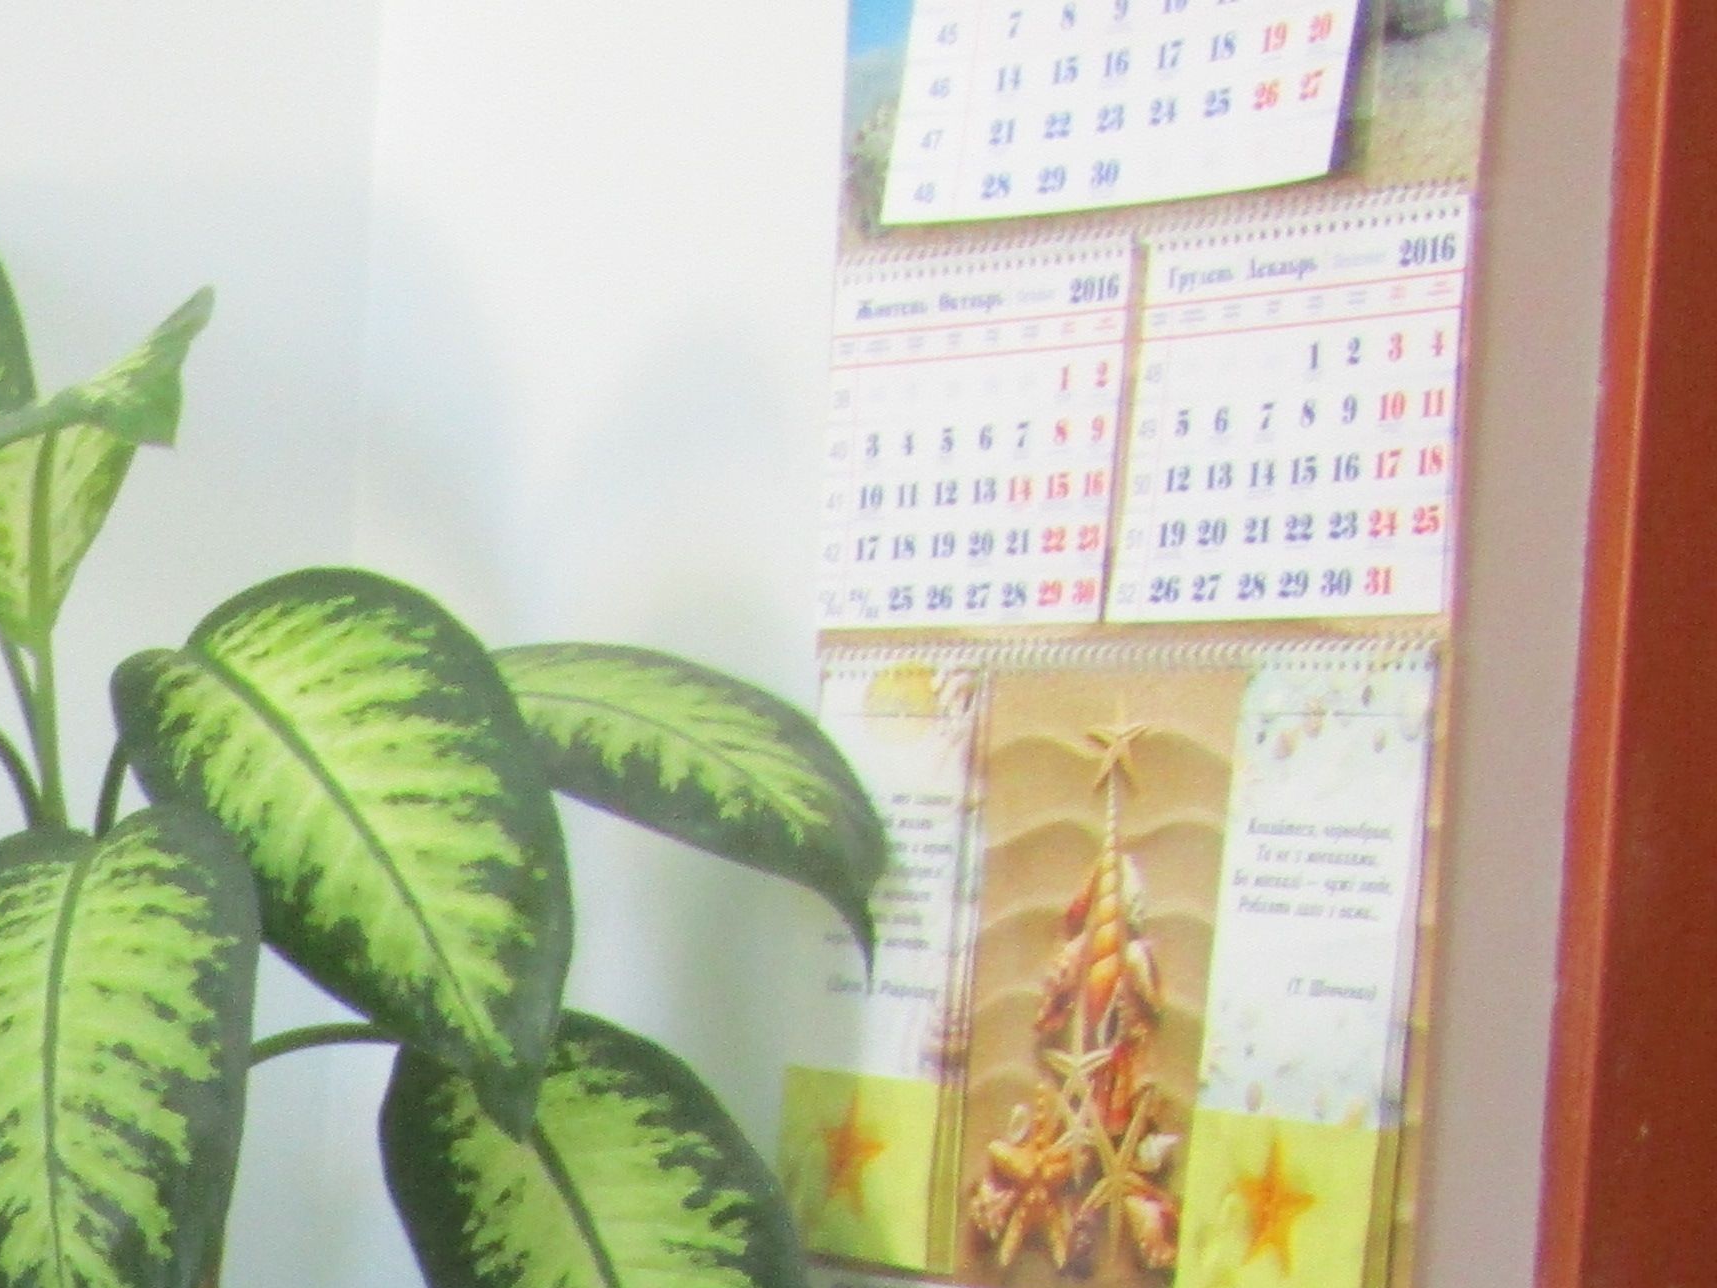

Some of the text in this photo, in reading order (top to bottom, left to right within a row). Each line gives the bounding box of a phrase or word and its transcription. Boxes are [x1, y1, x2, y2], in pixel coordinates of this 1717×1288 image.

[1009, 10, 1023, 38] 7
[997, 66, 1021, 92] 14
[1054, 56, 1079, 84] 15
[1105, 50, 1129, 77] 16
[1158, 39, 1183, 70] 17
[1211, 35, 1235, 60] 18
[1263, 21, 1290, 53] 19
[989, 119, 1015, 146] 21
[1044, 112, 1072, 139] 22
[1097, 104, 1125, 133] 23
[1150, 99, 1177, 126] 24
[1204, 88, 1230, 117] 25
[1253, 79, 1280, 110] 26
[1037, 166, 1067, 194] 29
[1091, 160, 1120, 186] 30
[1399, 233, 1456, 267] 2016
[1070, 274, 1119, 304] 2016
[1310, 341, 1320, 371] 1
[1347, 337, 1361, 365] 2
[1388, 333, 1405, 361] 3
[1061, 361, 1109, 391] 1 2
[1176, 410, 1190, 436] 5
[1214, 408, 1229, 433] 6
[1261, 402, 1274, 430] 7
[1300, 399, 1316, 427] 8
[1342, 395, 1358, 423] 9
[1380, 391, 1407, 421] 10
[1423, 389, 1445, 417] 11
[866, 433, 880, 458] 3
[941, 428, 954, 453] 5
[979, 426, 993, 450] 6
[1017, 421, 1029, 448] 7
[1092, 416, 1107, 442] 9
[1166, 466, 1191, 492] 12
[1207, 462, 1233, 490] 13
[1250, 462, 1275, 487] 14
[1291, 456, 1318, 485] 15
[1333, 454, 1360, 482] 16
[1376, 448, 1403, 479] 17
[1419, 448, 1443, 475] 18
[860, 485, 884, 510] 10
[898, 483, 918, 507] 11
[935, 480, 958, 506] 12
[973, 478, 997, 504] 13
[1008, 477, 1033, 502] 14
[1047, 472, 1070, 499] 15
[1084, 470, 1104, 496] 16
[856, 535, 880, 561] 17
[893, 537, 916, 559] 18
[932, 533, 956, 558] 19
[968, 532, 995, 558] 20
[1006, 529, 1029, 555] 21
[1042, 526, 1067, 554] 22
[1159, 521, 1186, 548] 19
[1197, 520, 1228, 546] 20
[1244, 517, 1269, 544] 21
[1285, 515, 1313, 542] 22
[1329, 511, 1358, 540] 23
[1369, 510, 1398, 538] 24
[1412, 505, 1440, 535] 25
[889, 586, 913, 612] 25
[927, 586, 953, 611] 26
[966, 582, 991, 609] 27
[1038, 580, 1064, 607] 29
[1149, 577, 1180, 603] 26
[1192, 574, 1221, 602] 27
[1238, 574, 1266, 600] 28
[1278, 570, 1309, 598] 29
[1321, 569, 1352, 596] 30
[1365, 567, 1392, 595] 31
